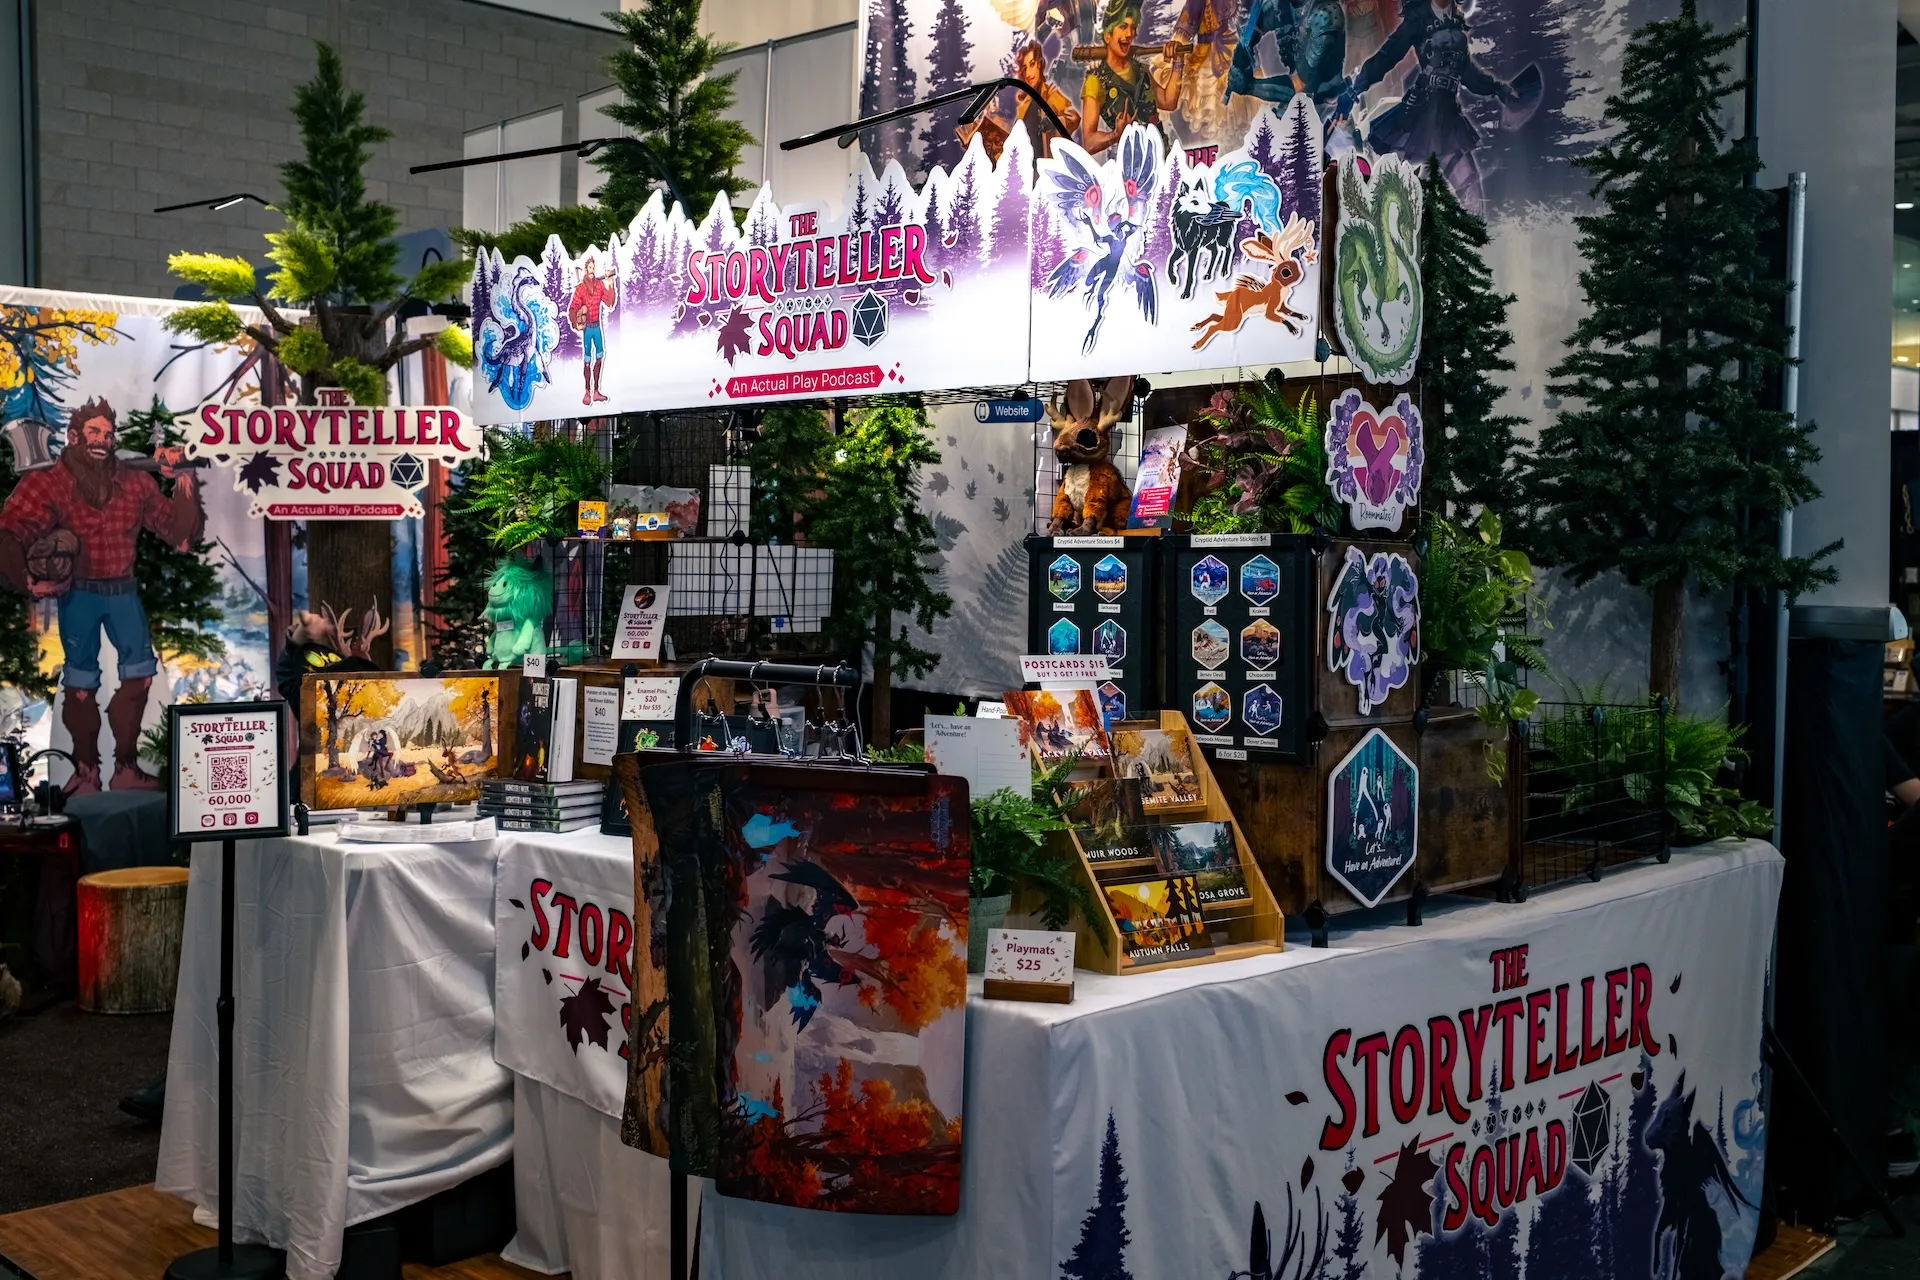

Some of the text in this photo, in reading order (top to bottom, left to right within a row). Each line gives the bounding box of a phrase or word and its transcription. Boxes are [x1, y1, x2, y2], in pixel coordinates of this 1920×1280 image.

[789, 212, 818, 238] THE
[686, 224, 936, 304] STORYTELLER
[757, 309, 848, 360] SQUAD
[732, 370, 875, 394] An Actual Play Podcast
[319, 390, 349, 406] THE
[995, 405, 1029, 416] Website
[201, 404, 471, 452] STORYTELLER
[288, 458, 385, 494] SQUAD
[273, 505, 399, 518] An Actual Play Podcast
[1359, 502, 1396, 521] Roommates?
[1057, 538, 1073, 546] Cryptid
[1195, 536, 1213, 544] Cryptid
[623, 612, 659, 620] STORYTELLER
[527, 657, 540, 667] $40
[1025, 660, 1105, 669] POSTCARDS $15
[645, 695, 658, 703] $20
[594, 706, 606, 717] $40
[191, 720, 268, 734] STORYTELLER
[215, 735, 244, 744] SQUAD
[936, 730, 967, 738] Adventure!
[208, 794, 251, 806] 60,000
[1170, 793, 1198, 803] VALLEY
[1084, 846, 1139, 860] MUIR WOODS
[1344, 853, 1402, 873] Have an Adventure!
[1218, 886, 1245, 897] GROVE
[1006, 943, 1056, 956] Playmats
[1129, 942, 1190, 959] AUTUMN FALLS
[1016, 958, 1041, 971] $25
[1488, 944, 1529, 994] THE
[1319, 963, 1661, 1151] STORYTELLER
[1443, 1118, 1566, 1231] SQUAD
